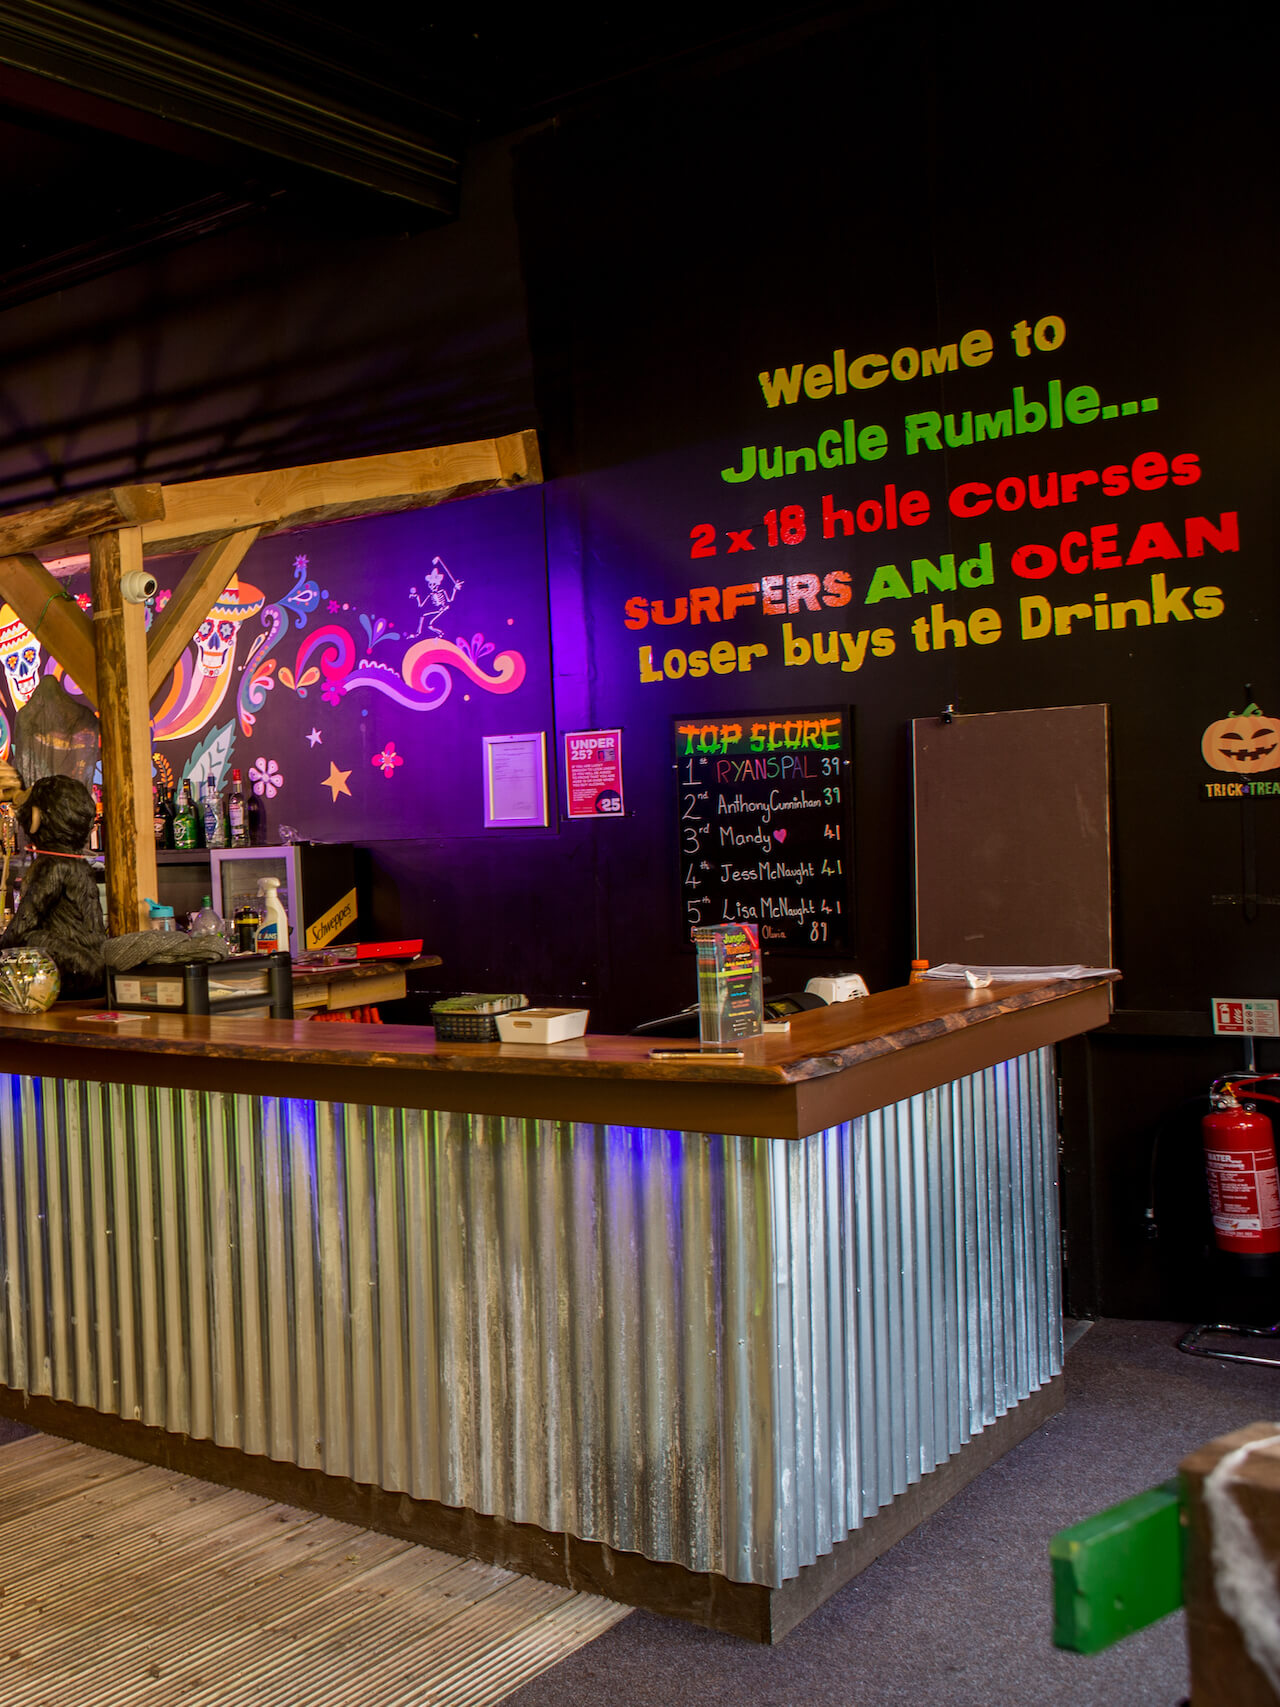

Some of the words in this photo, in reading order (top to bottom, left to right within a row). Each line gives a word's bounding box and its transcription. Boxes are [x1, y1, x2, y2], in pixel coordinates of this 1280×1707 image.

[758, 329, 994, 408] Welcome
[1011, 315, 1066, 357] to
[720, 419, 888, 484] Jungle
[689, 523, 716, 559] 2
[726, 530, 755, 554] x
[763, 505, 807, 547] 18
[822, 484, 931, 540] hole
[948, 452, 1202, 519] courses
[624, 570, 853, 631] SURFERS
[1011, 511, 1240, 581] OCEAN
[639, 639, 768, 684] Loser
[782, 624, 895, 673] buys
[912, 603, 1002, 653] the
[1020, 572, 1225, 640] Drinks
[570, 738, 615, 750] UNDER
[678, 723, 742, 754] TOP
[750, 718, 841, 751] SCORE
[571, 749, 593, 761] 25?
[821, 756, 840, 776] 39
[823, 787, 841, 805] 39
[1205, 783, 1243, 798] TRICK
[1248, 781, 1280, 796] TREA
[601, 797, 621, 812] 25
[719, 826, 772, 853] Mandy
[824, 824, 840, 840] 41
[721, 863, 758, 883] Jess
[821, 859, 842, 876] 41
[723, 898, 758, 921] Lisa
[821, 899, 841, 915] 41
[312, 902, 352, 945] Schweppes
[810, 921, 828, 942] 89
